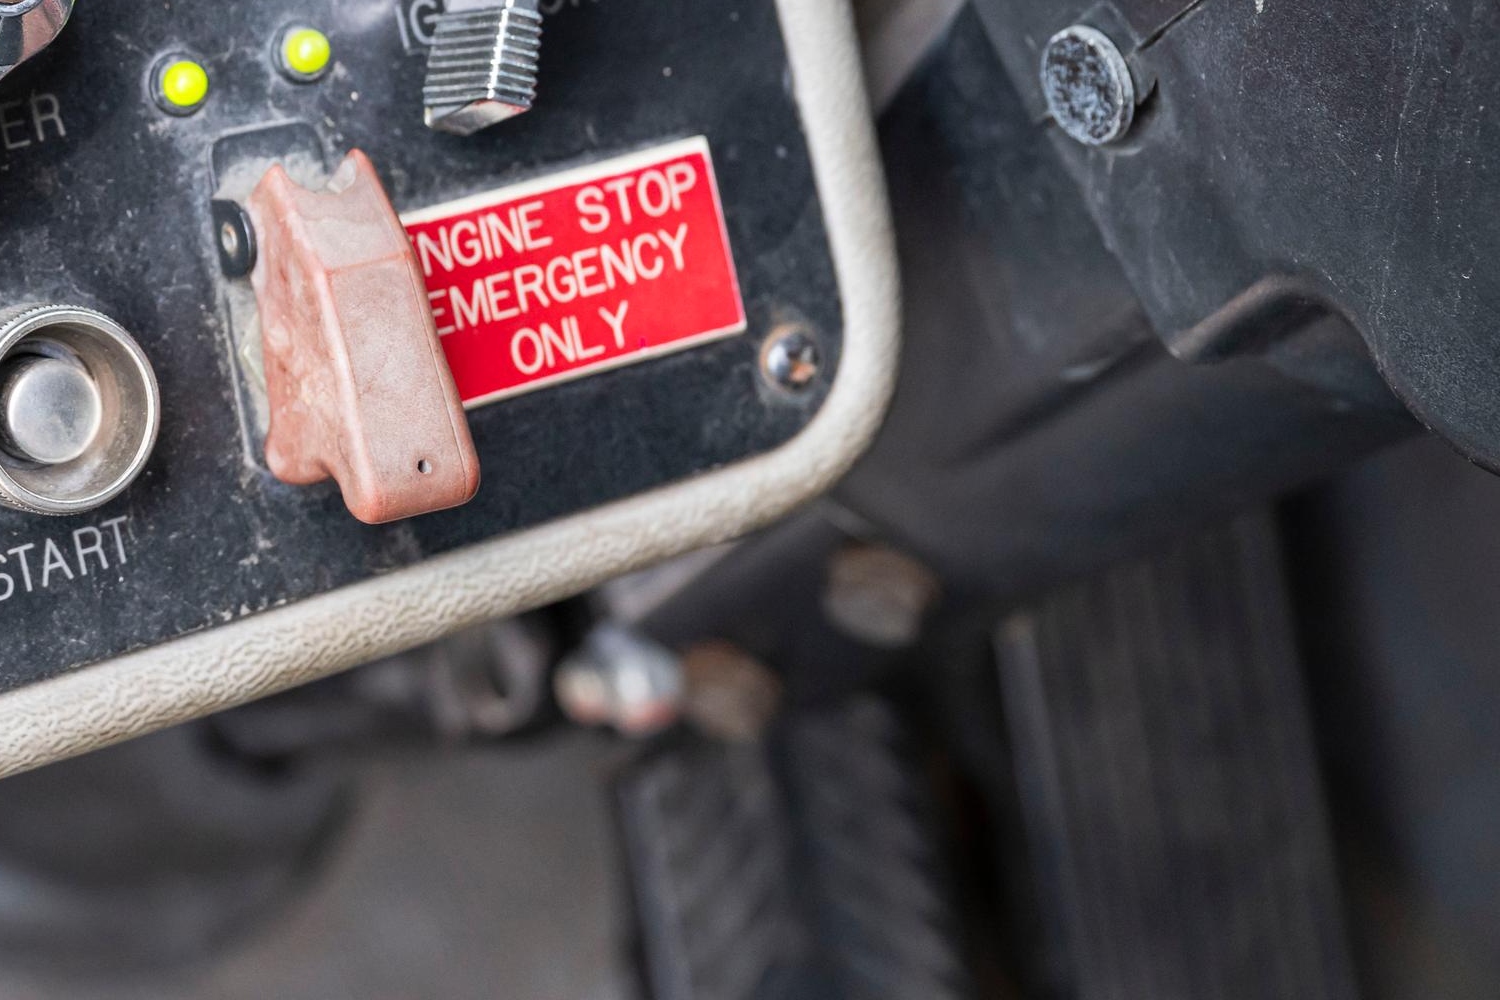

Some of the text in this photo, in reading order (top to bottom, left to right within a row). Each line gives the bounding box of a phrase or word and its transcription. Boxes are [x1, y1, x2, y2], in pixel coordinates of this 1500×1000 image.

[406, 162, 697, 276] NGINE STOP
[428, 223, 688, 335] EMERGENCY
[511, 300, 629, 374] ONLY
